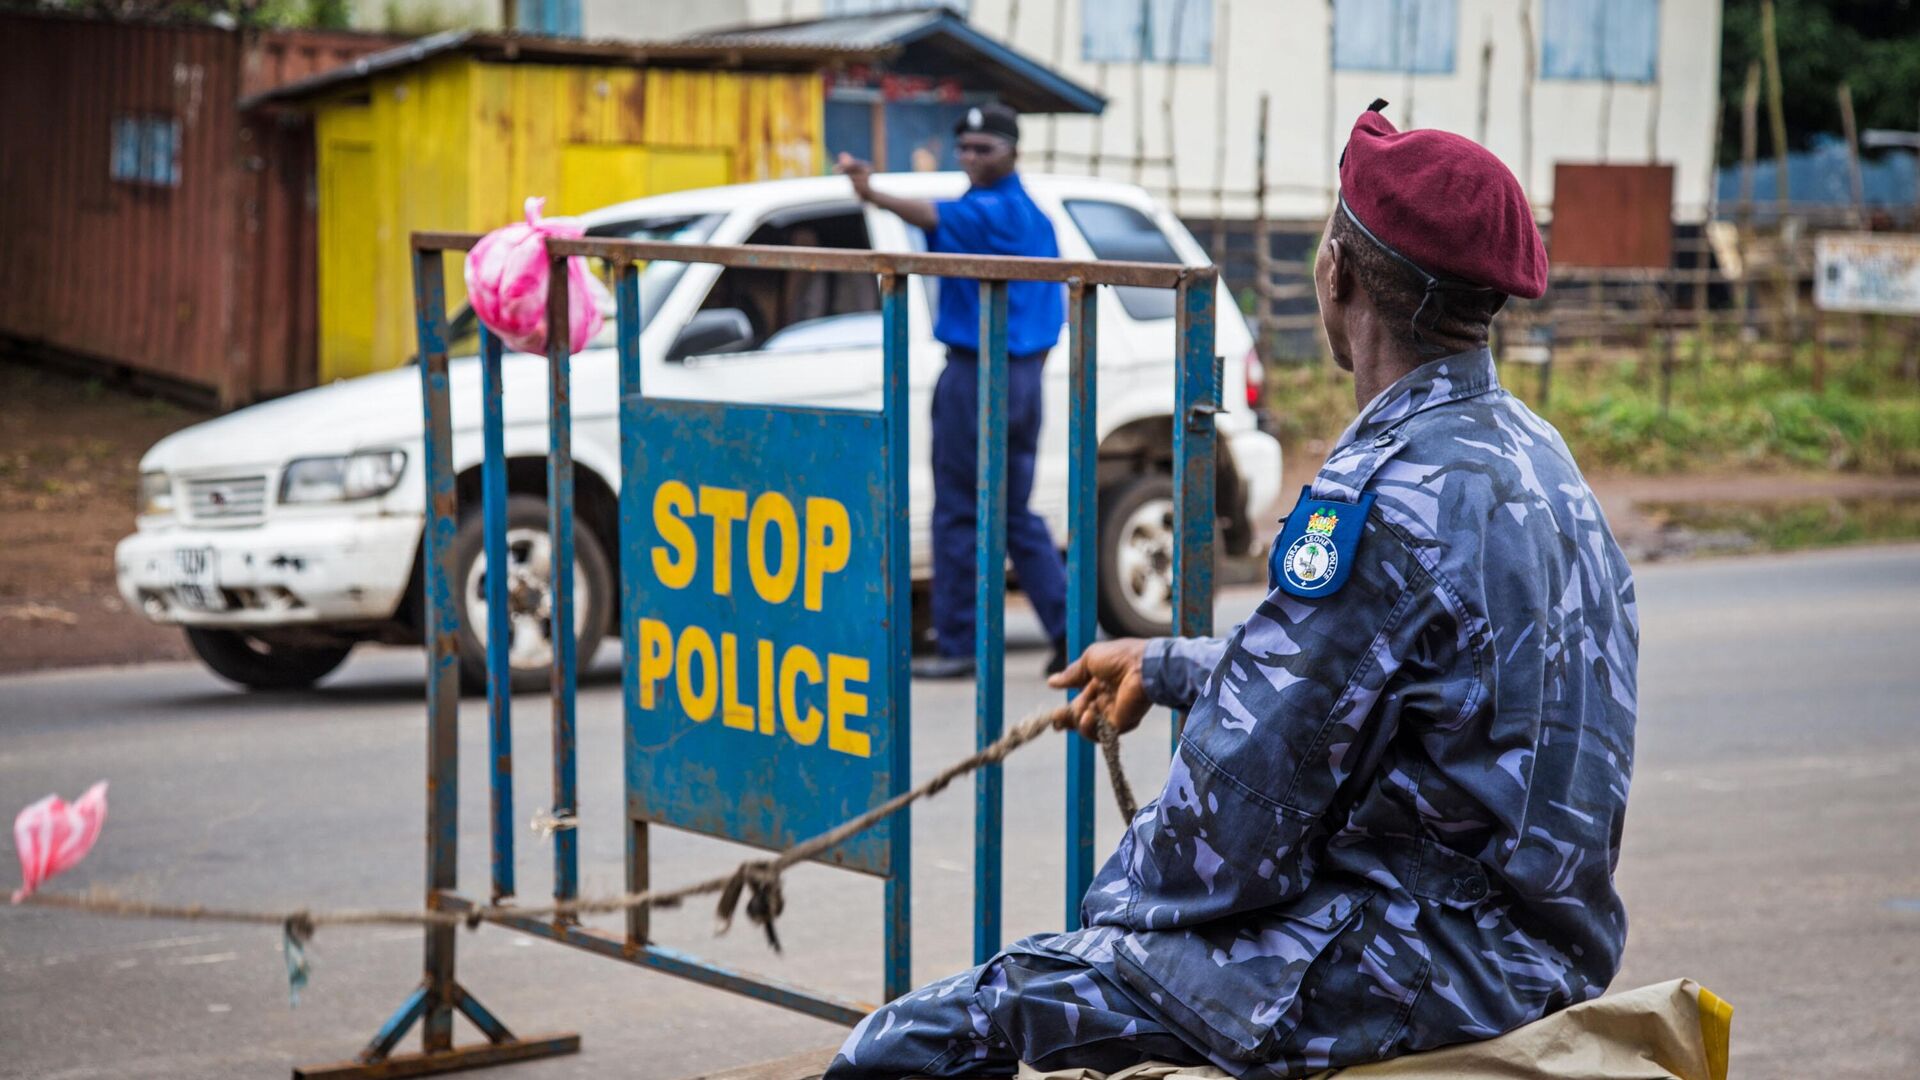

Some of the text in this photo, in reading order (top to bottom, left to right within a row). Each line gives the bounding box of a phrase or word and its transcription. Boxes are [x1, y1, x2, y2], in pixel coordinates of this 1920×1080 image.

[651, 480, 851, 612] STOP
[1286, 535, 1336, 580] SIERRA LEONE POLICE
[639, 617, 871, 759] POLICE
